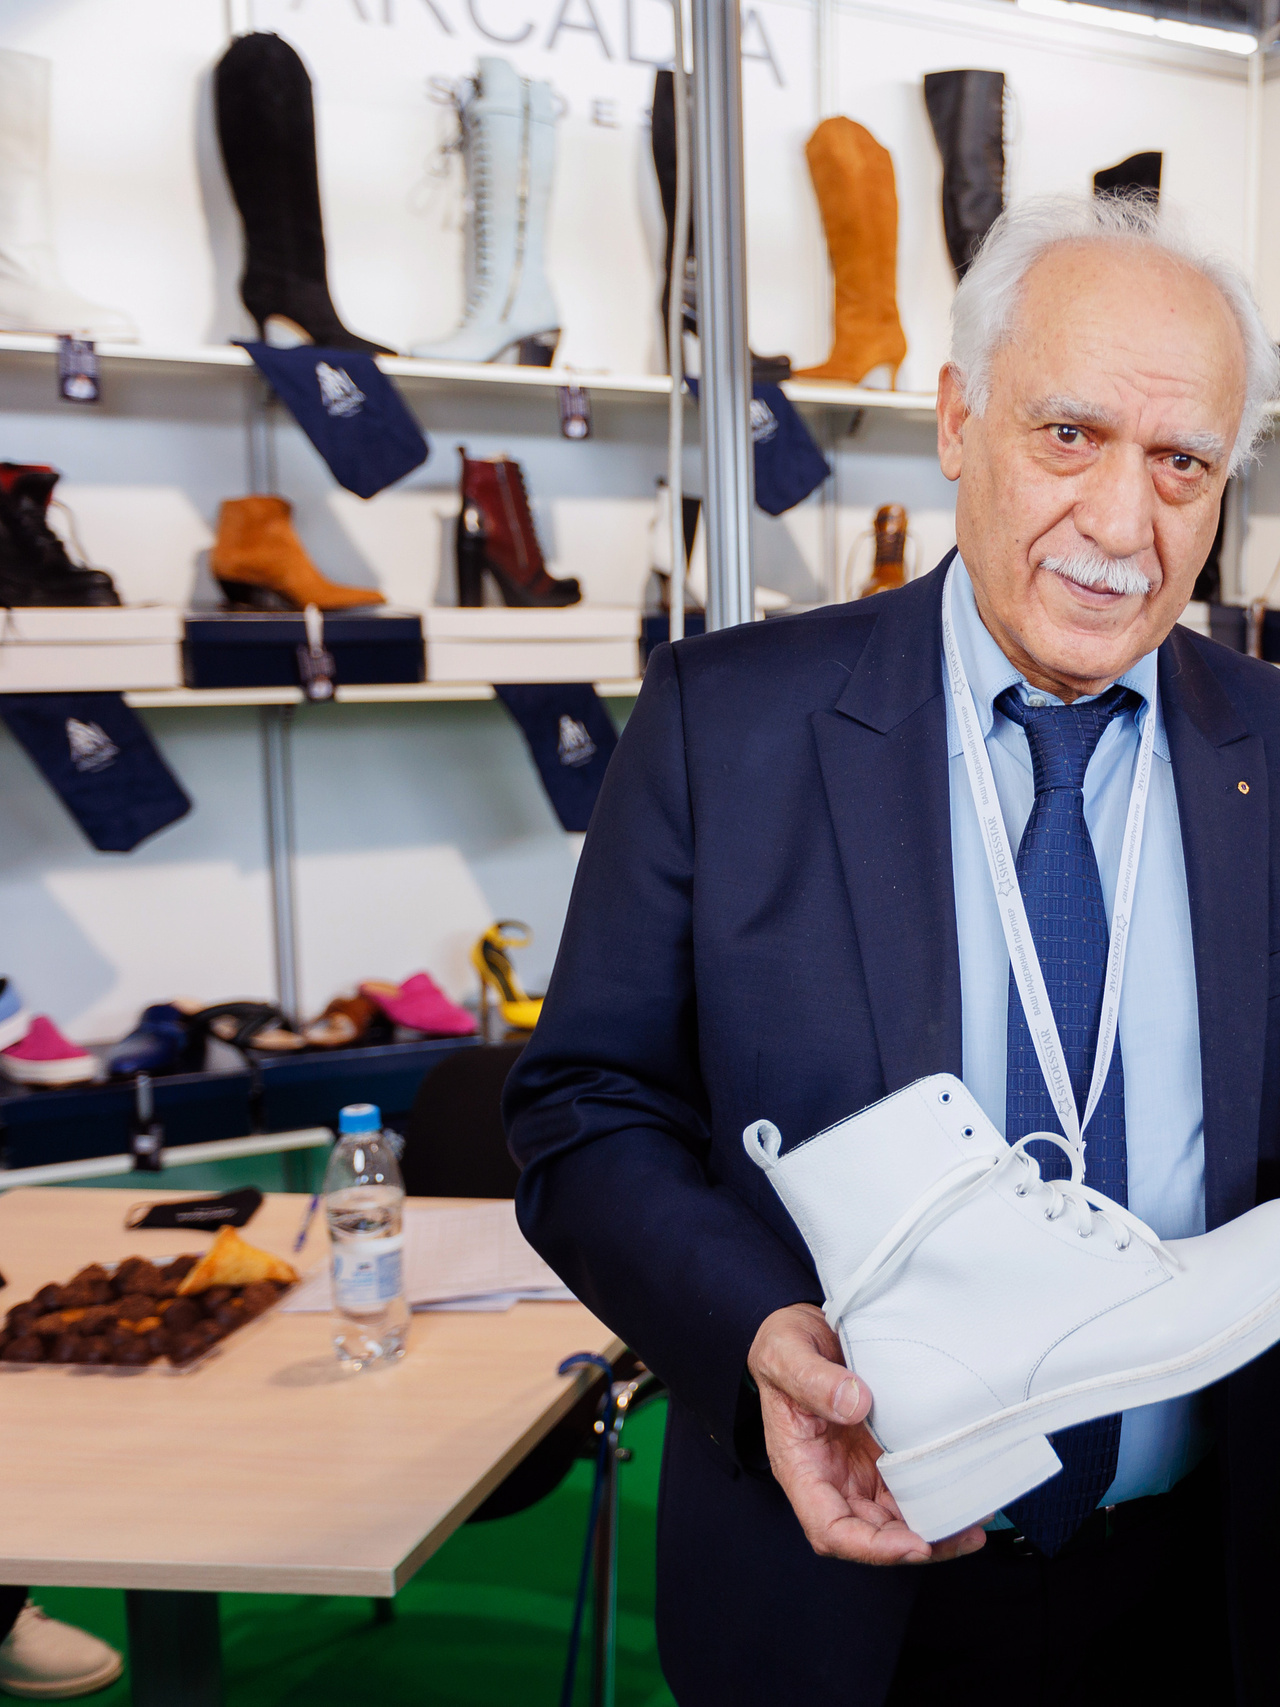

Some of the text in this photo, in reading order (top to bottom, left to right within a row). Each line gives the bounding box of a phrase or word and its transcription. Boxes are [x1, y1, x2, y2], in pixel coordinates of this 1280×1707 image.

[291, 0, 797, 90] CADA
[943, 620, 961, 679] SHOESSTAR
[961, 706, 990, 806] ВАШ НАДЕЖНЫЙ ПАРТНЕР
[1137, 733, 1152, 790] SHOESSTAR
[1133, 803, 1141, 825] ВАШ
[987, 815, 1010, 879] SHOESSTAR
[1122, 870, 1132, 904] ПАРТНЕР
[1008, 908, 1041, 1016] ВАШ НАДЕЖНЫЙ ПАРТНЕР
[1108, 931, 1122, 993] SHOESSTAR
[1041, 1028, 1066, 1096] SHOESSTAR
